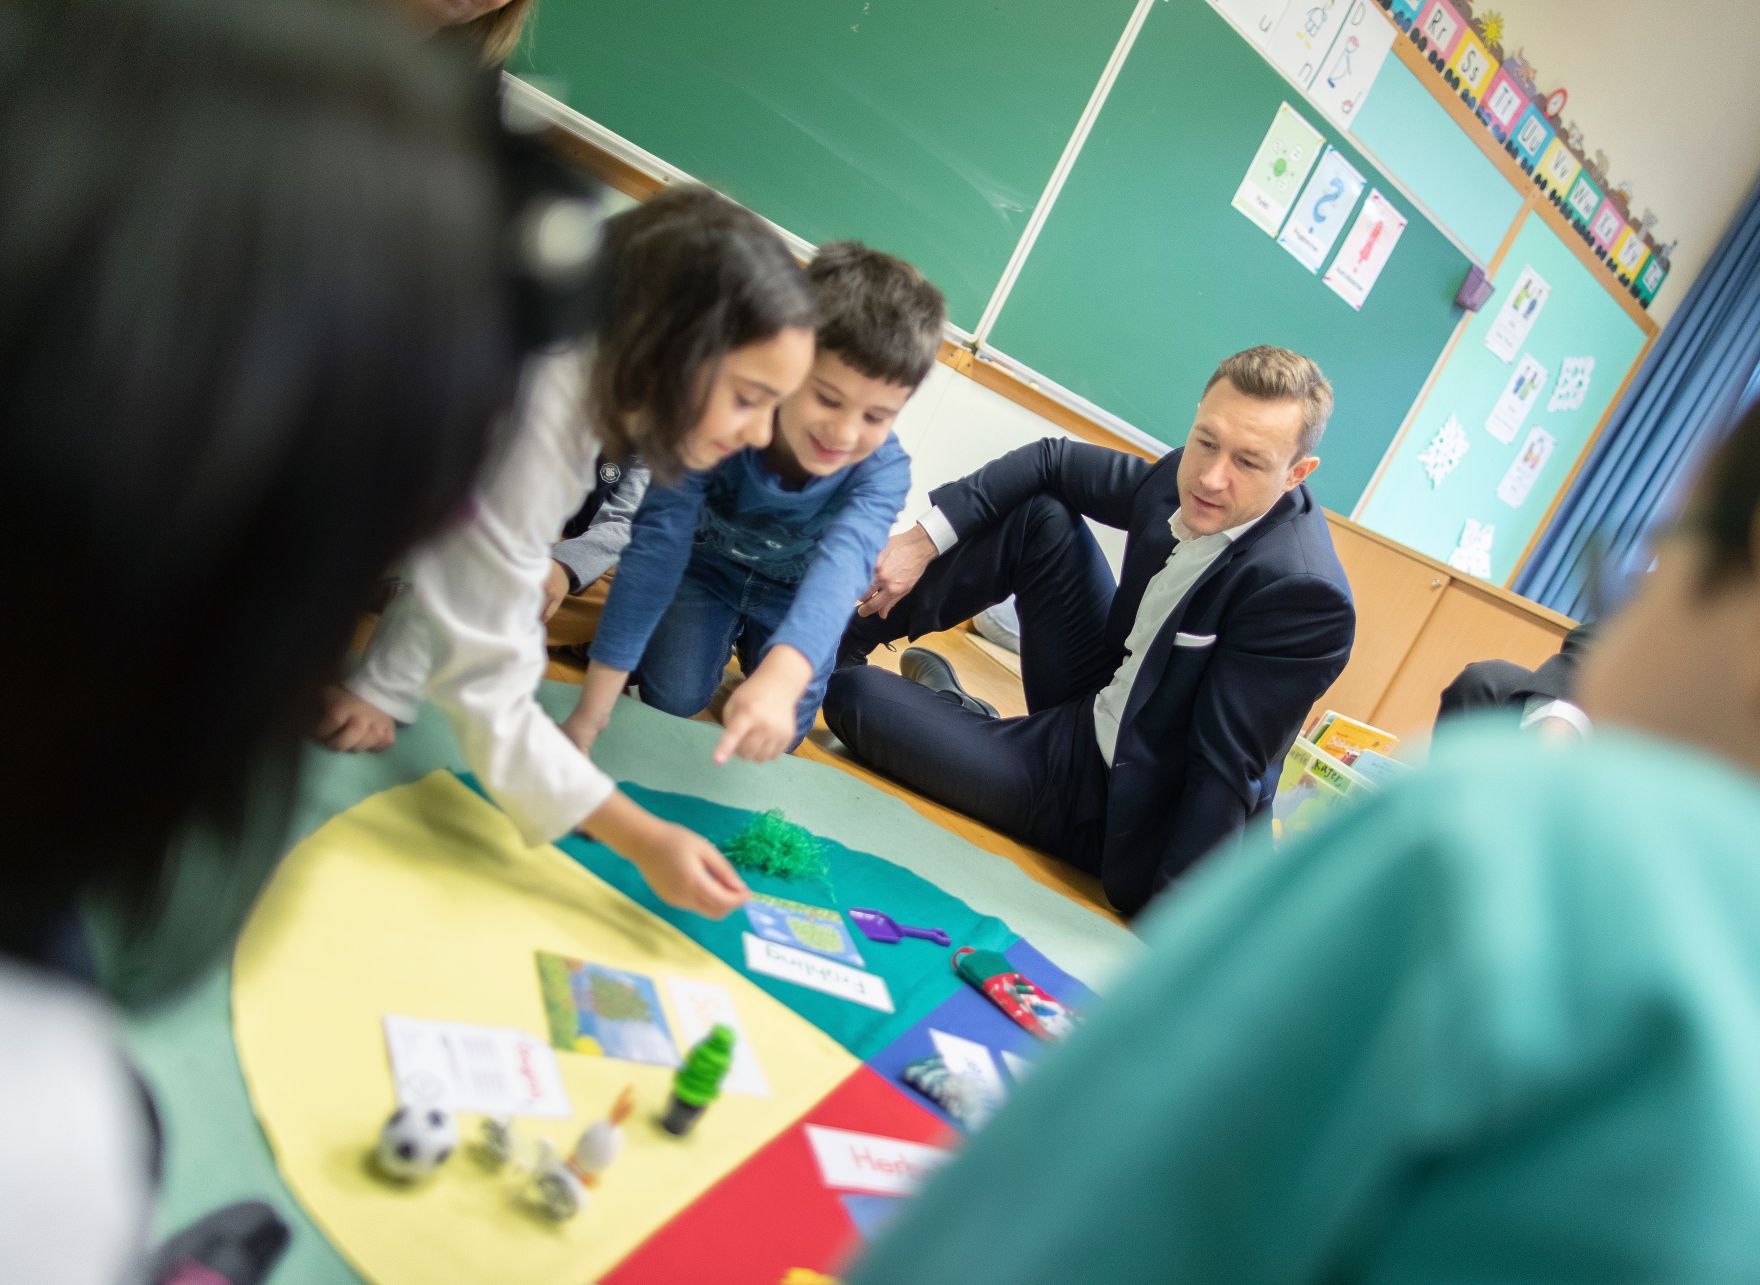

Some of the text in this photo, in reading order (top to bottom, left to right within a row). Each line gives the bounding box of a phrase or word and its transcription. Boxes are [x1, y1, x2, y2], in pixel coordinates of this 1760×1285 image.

[1427, 9, 1447, 41] Rr
[1461, 50, 1480, 82] Ss
[1495, 86, 1512, 117] Tt
[1521, 116, 1541, 152] Uu
[1553, 150, 1568, 178] Vv
